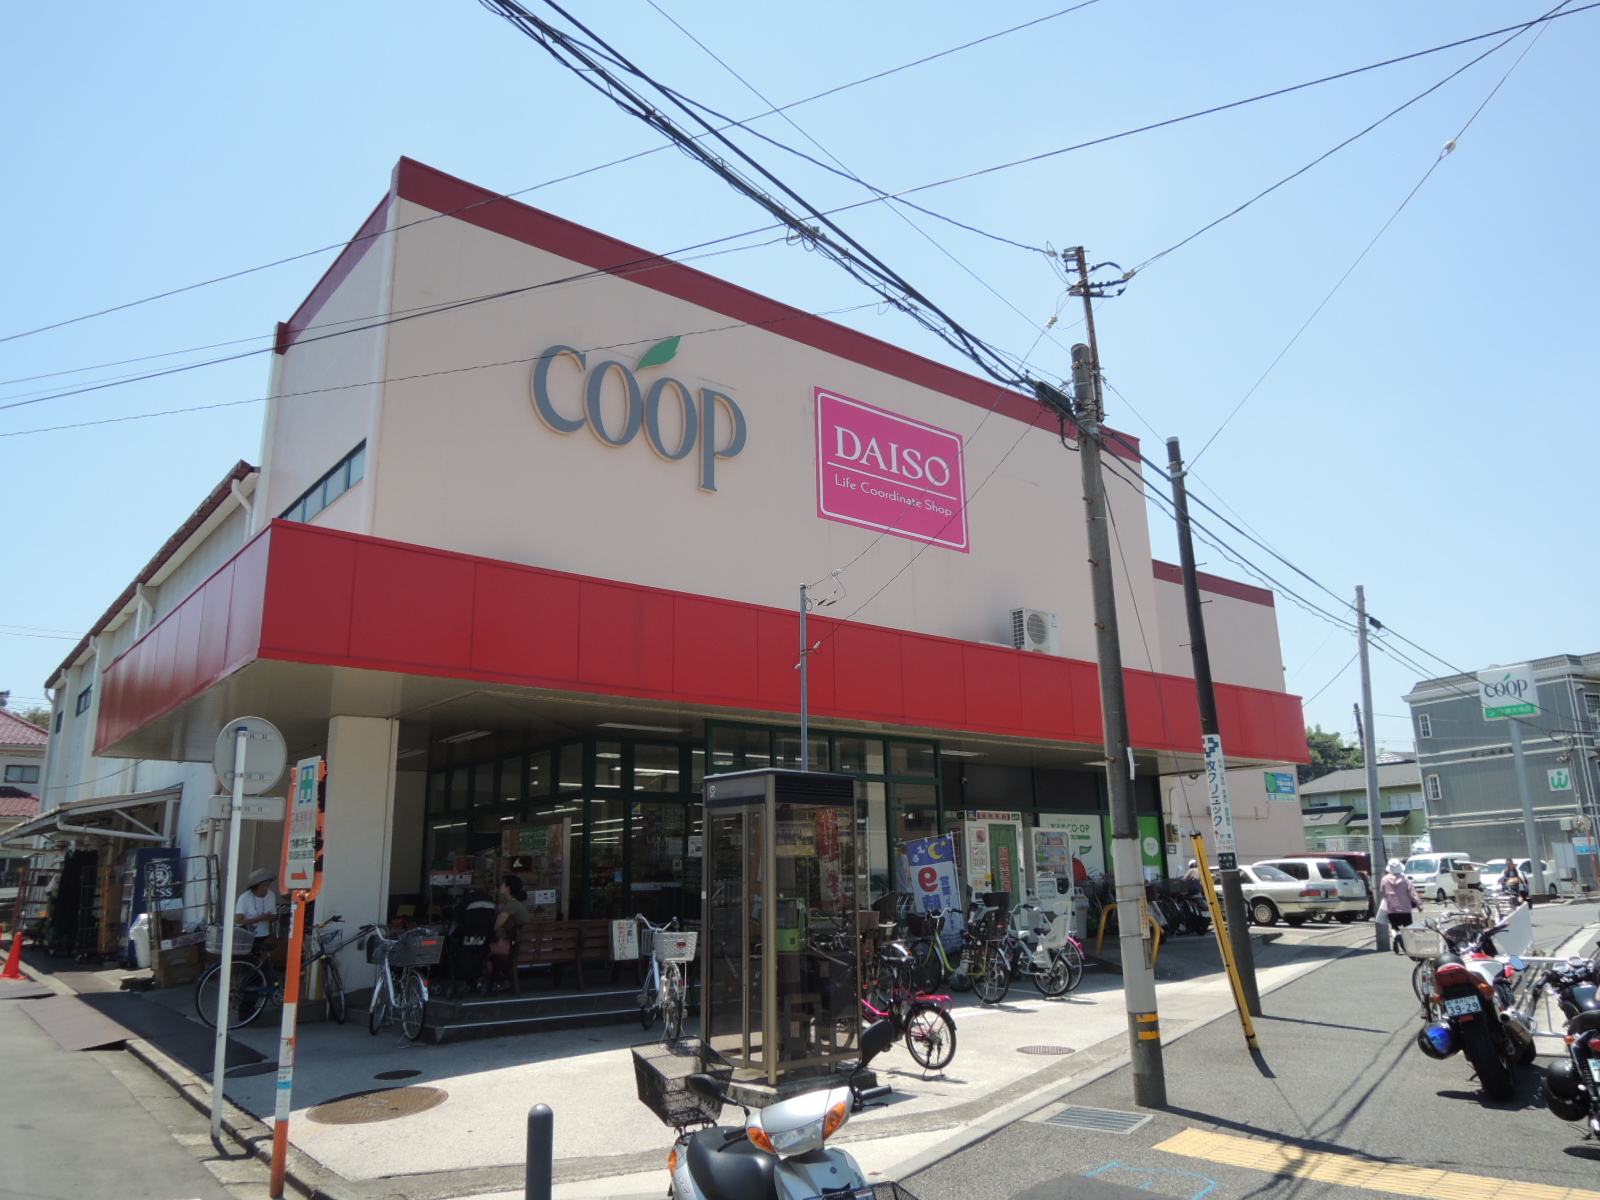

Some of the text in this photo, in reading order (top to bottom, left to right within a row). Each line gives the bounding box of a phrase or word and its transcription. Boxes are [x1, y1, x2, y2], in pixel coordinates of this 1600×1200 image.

[834, 425, 951, 487] DAISO
[835, 473, 953, 517] Life Coordinate Shop
[1487, 705, 1532, 717] コプ神大寺店
